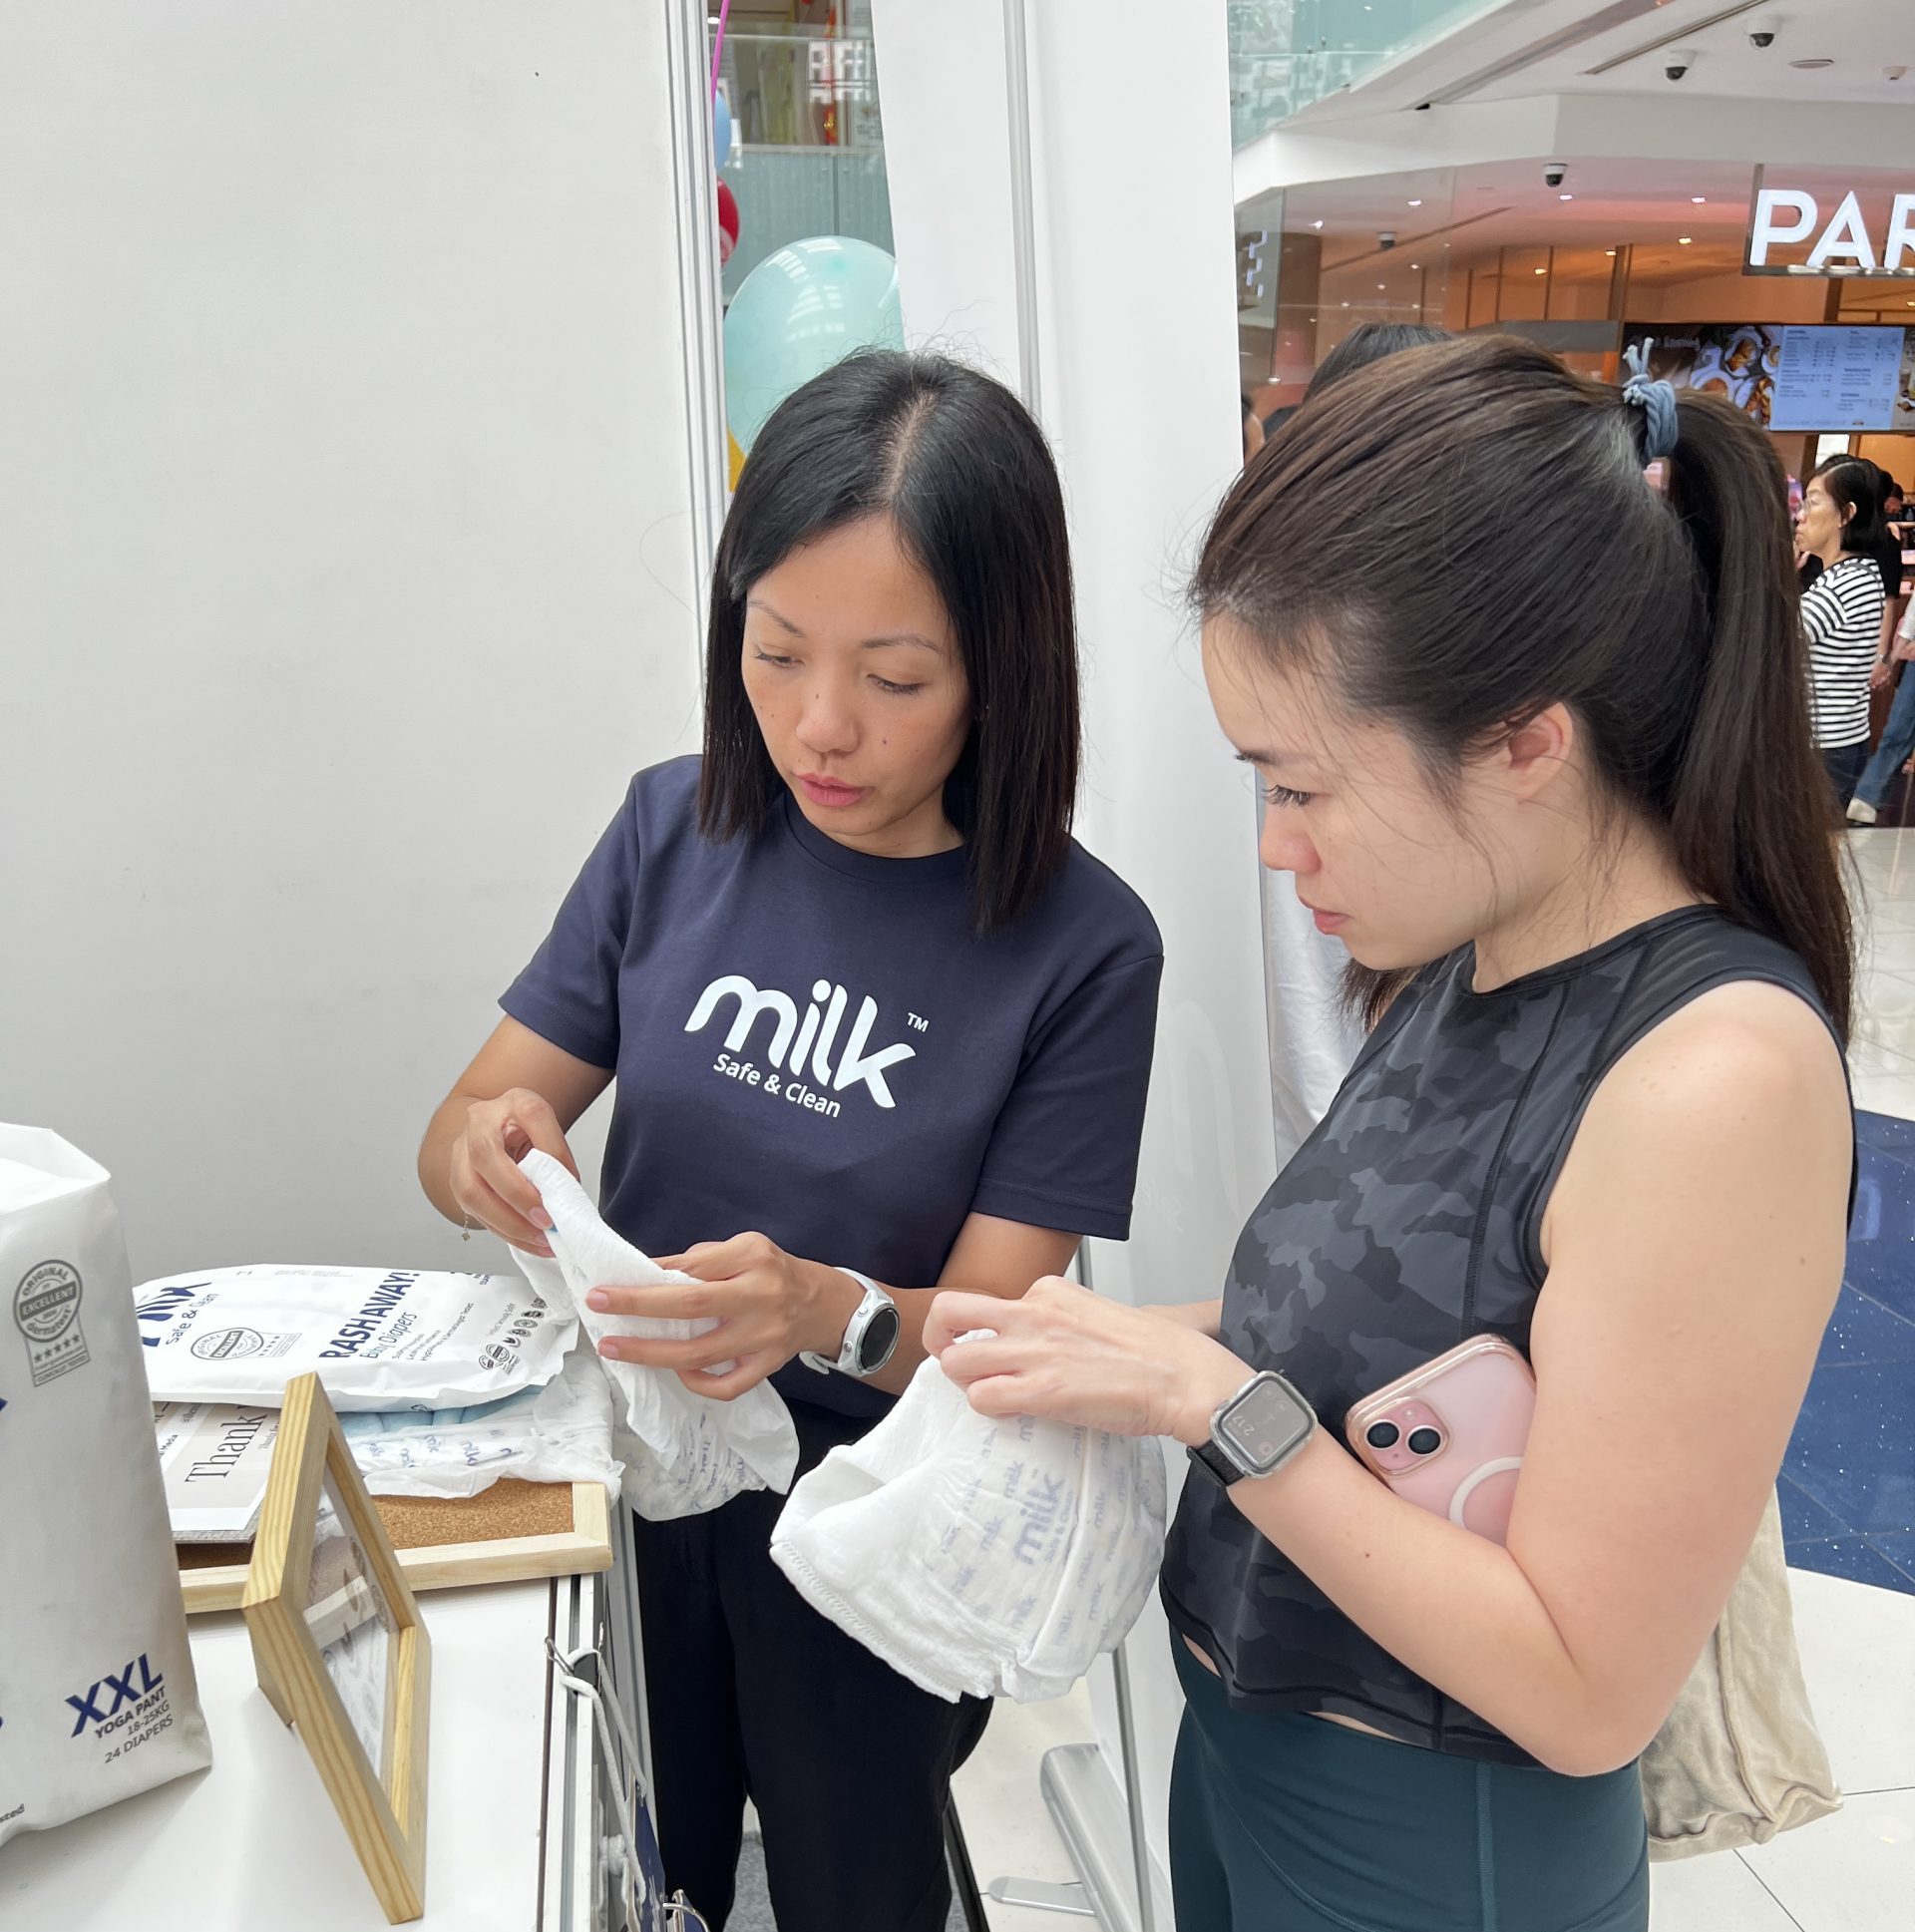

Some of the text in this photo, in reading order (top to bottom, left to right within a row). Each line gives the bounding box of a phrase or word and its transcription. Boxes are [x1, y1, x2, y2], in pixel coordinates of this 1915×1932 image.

[684, 974, 917, 1108] milk
[907, 1011, 930, 1032] TM
[713, 1052, 842, 1118] Safe & Clean
[22, 1267, 69, 1297] ORIGINAL
[22, 1285, 75, 1316] EXCELLENT
[166, 1323, 192, 1345] Safe
[182, 1310, 198, 1319] &
[318, 1318, 382, 1357] RASH
[359, 1272, 421, 1318] AWAY!
[378, 1312, 418, 1344] Diapers
[185, 1413, 268, 1482] Thank
[1002, 1459, 1024, 1499] milk
[1013, 1472, 1064, 1566] milk
[65, 1652, 164, 1739] XXL
[95, 1686, 166, 1739] YOGA PANT
[105, 1714, 174, 1764] 24 DIAPERS
[127, 1700, 171, 1737] 18-25KG
[0, 1803, 26, 1823] sted
